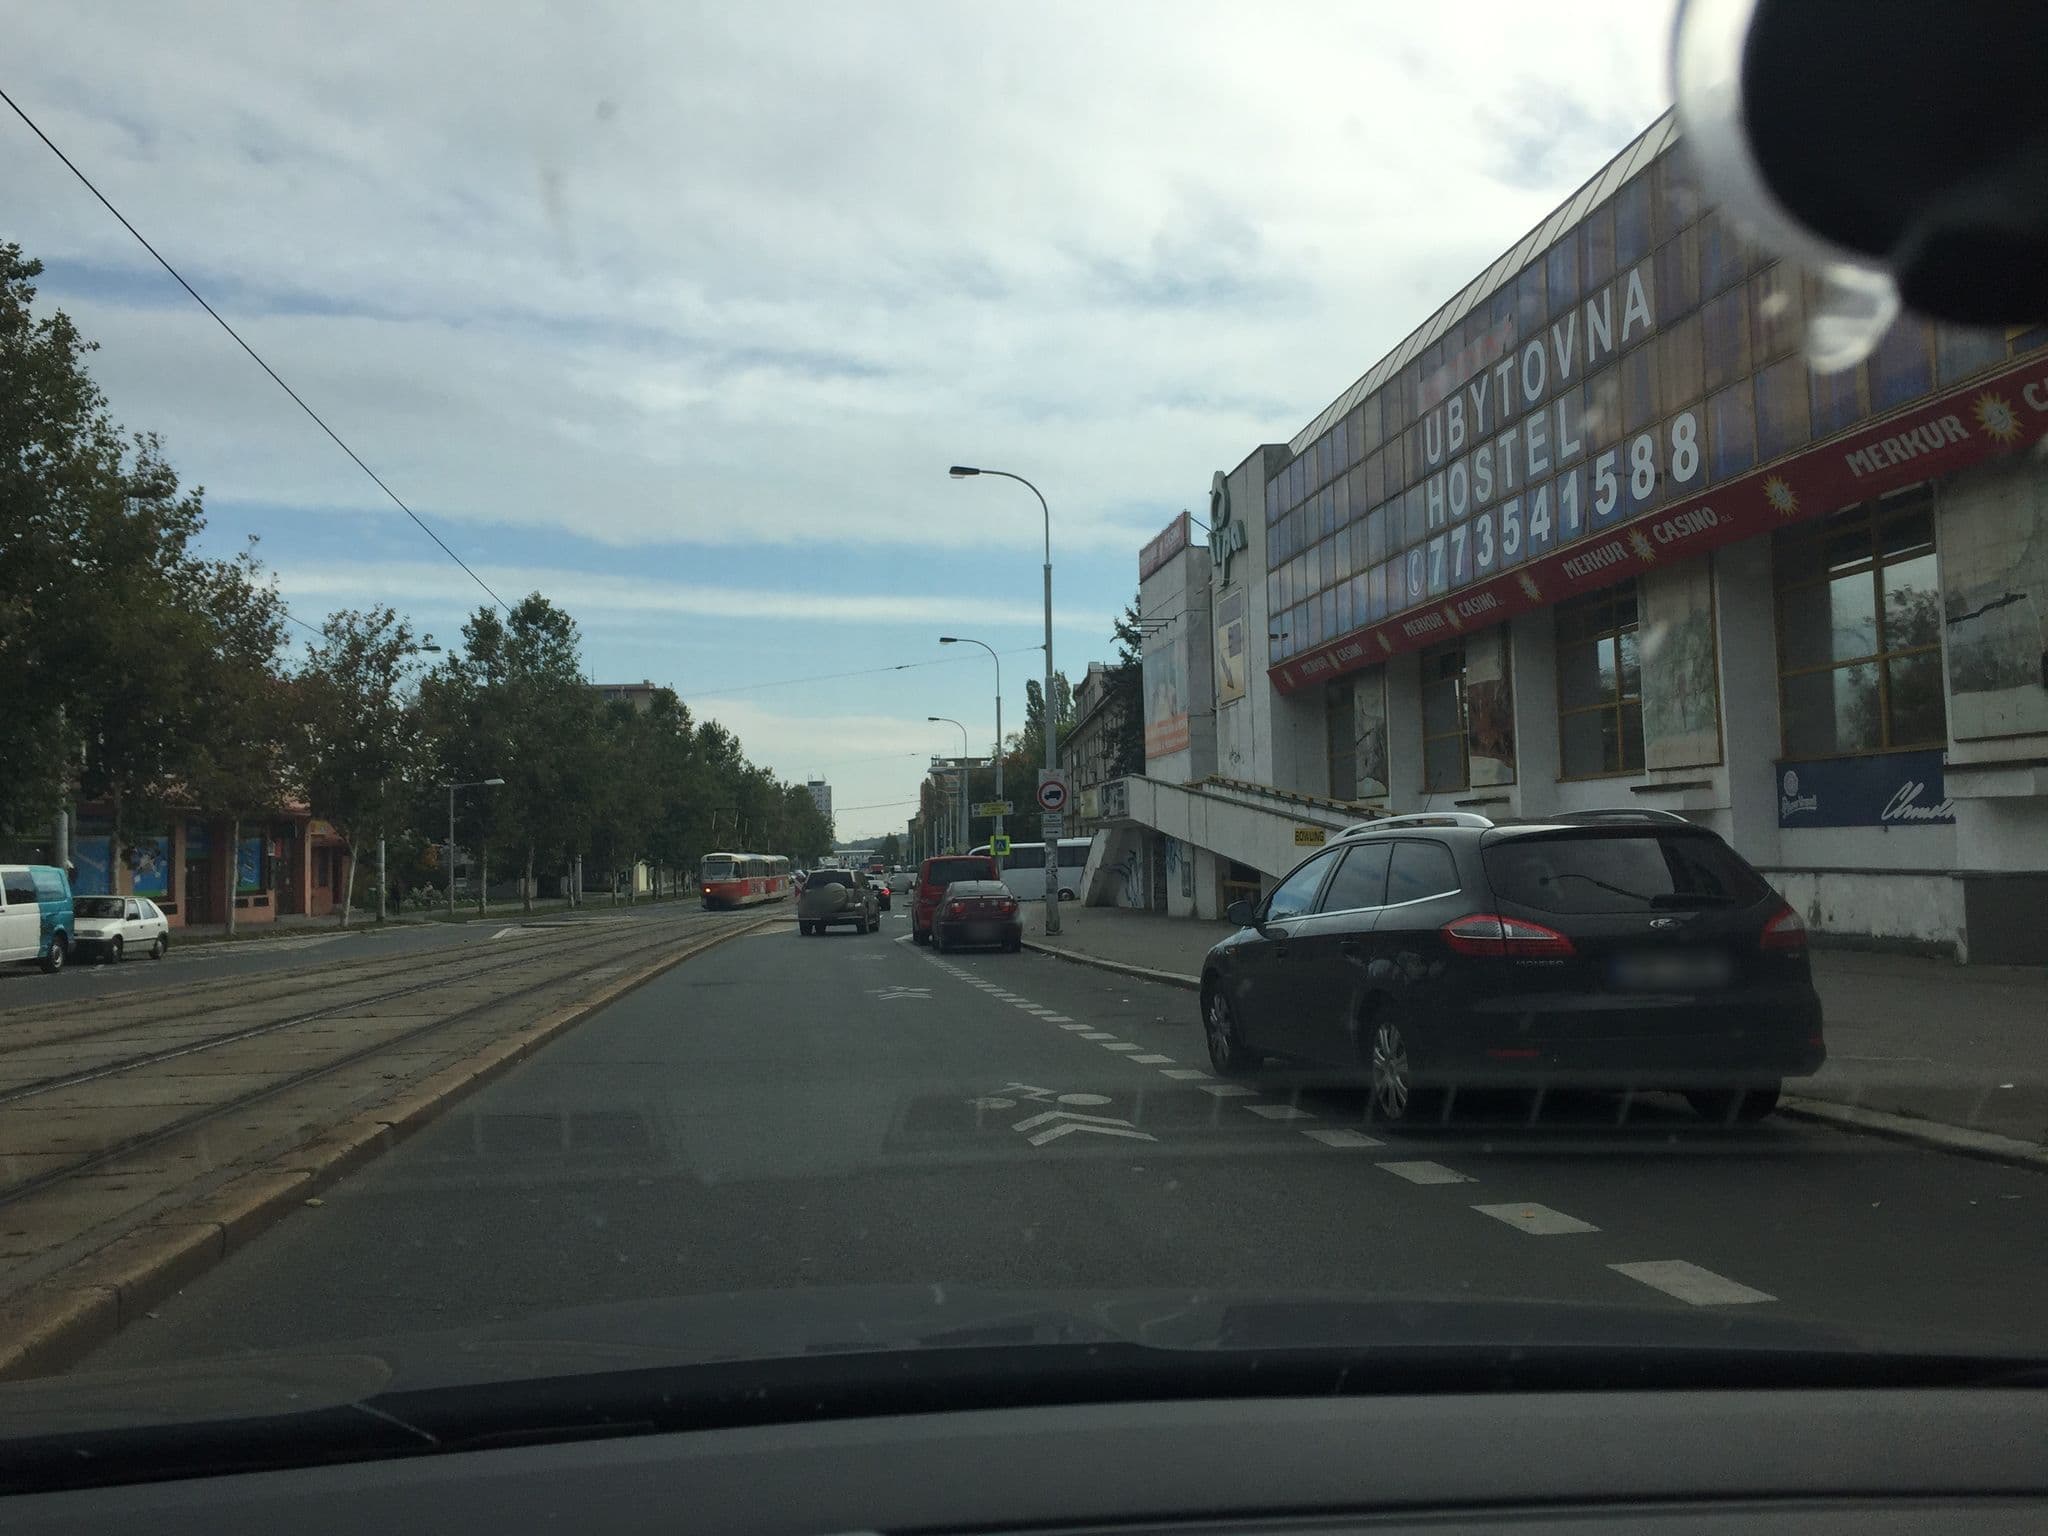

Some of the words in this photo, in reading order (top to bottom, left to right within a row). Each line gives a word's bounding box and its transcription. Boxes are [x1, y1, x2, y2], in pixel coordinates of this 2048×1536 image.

[1425, 267, 1652, 466] UBYTOVNA
[1427, 397, 1581, 531] HOSTEL
[1844, 414, 1970, 478] MERKUR
[1429, 411, 1699, 587] 773541588
[1562, 541, 1629, 580] MERKUR
[1651, 507, 1720, 544] CASINO
[1403, 611, 1446, 639] MERKUR
[1457, 591, 1497, 618] CASINO
[1295, 830, 1325, 842] BOWLING
